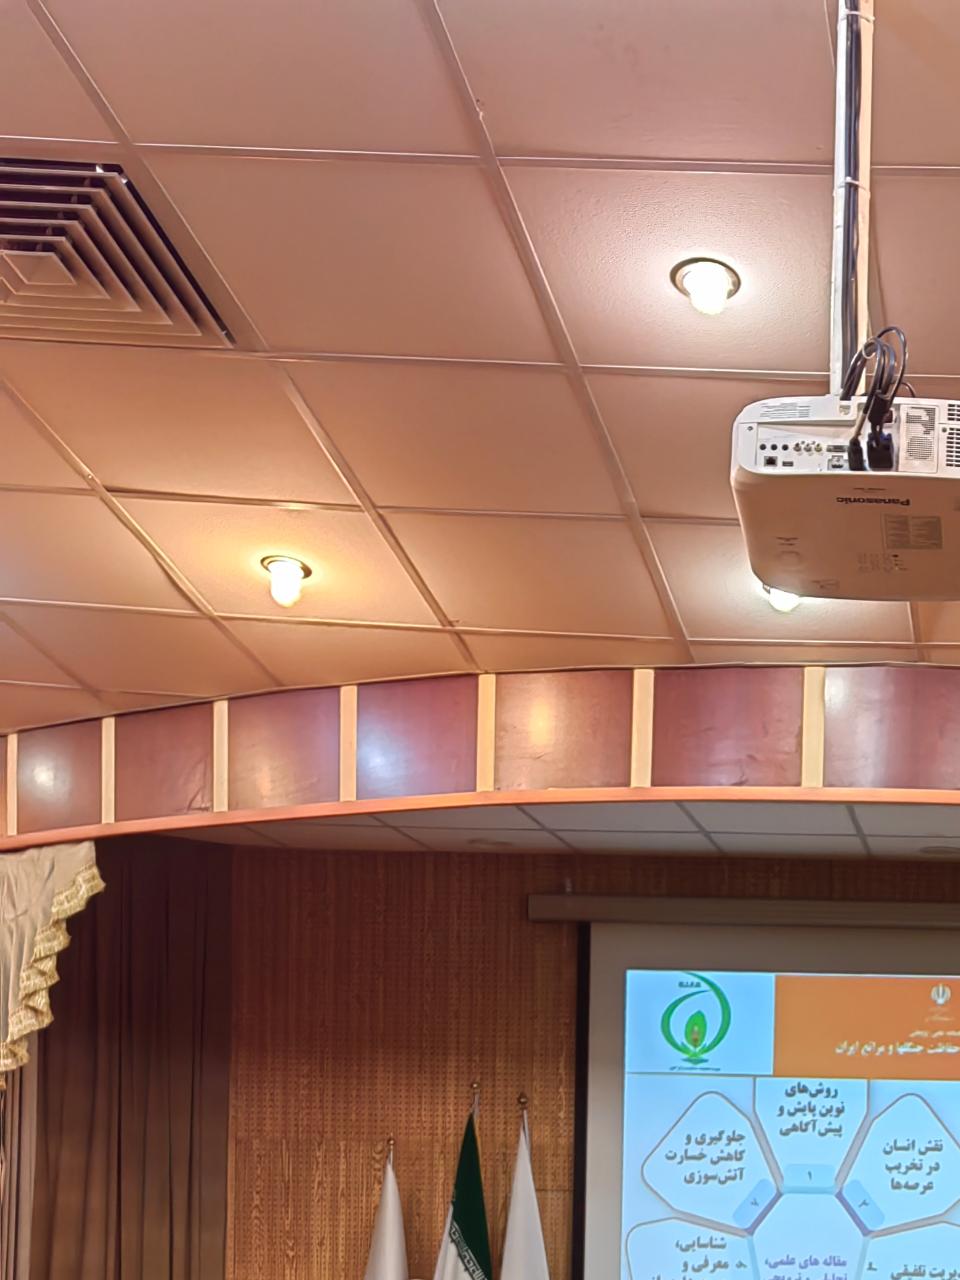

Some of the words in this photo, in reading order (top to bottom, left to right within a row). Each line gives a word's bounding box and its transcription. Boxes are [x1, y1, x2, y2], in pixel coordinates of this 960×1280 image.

[836, 496, 910, 506] Panasonic
[835, 1040, 859, 1055] ایران
[777, 1105, 784, 1117] و
[787, 1101, 816, 1117] پایش
[819, 1101, 845, 1117] نوین
[685, 1134, 692, 1145] و
[695, 1130, 745, 1146] جلوگیری
[883, 1139, 916, 1155] انسان
[918, 1139, 943, 1155] نقش
[665, 1149, 707, 1165] خسارت
[710, 1149, 745, 1165] کاهش
[885, 1158, 923, 1175] تخریب
[926, 1162, 940, 1175] در
[682, 1261, 688, 1273] و
[692, 1255, 729, 1273] معرفی
[800, 1255, 820, 1269] های
[823, 1255, 847, 1268] مقاله
[890, 1264, 926, 1280] تلفیقی
